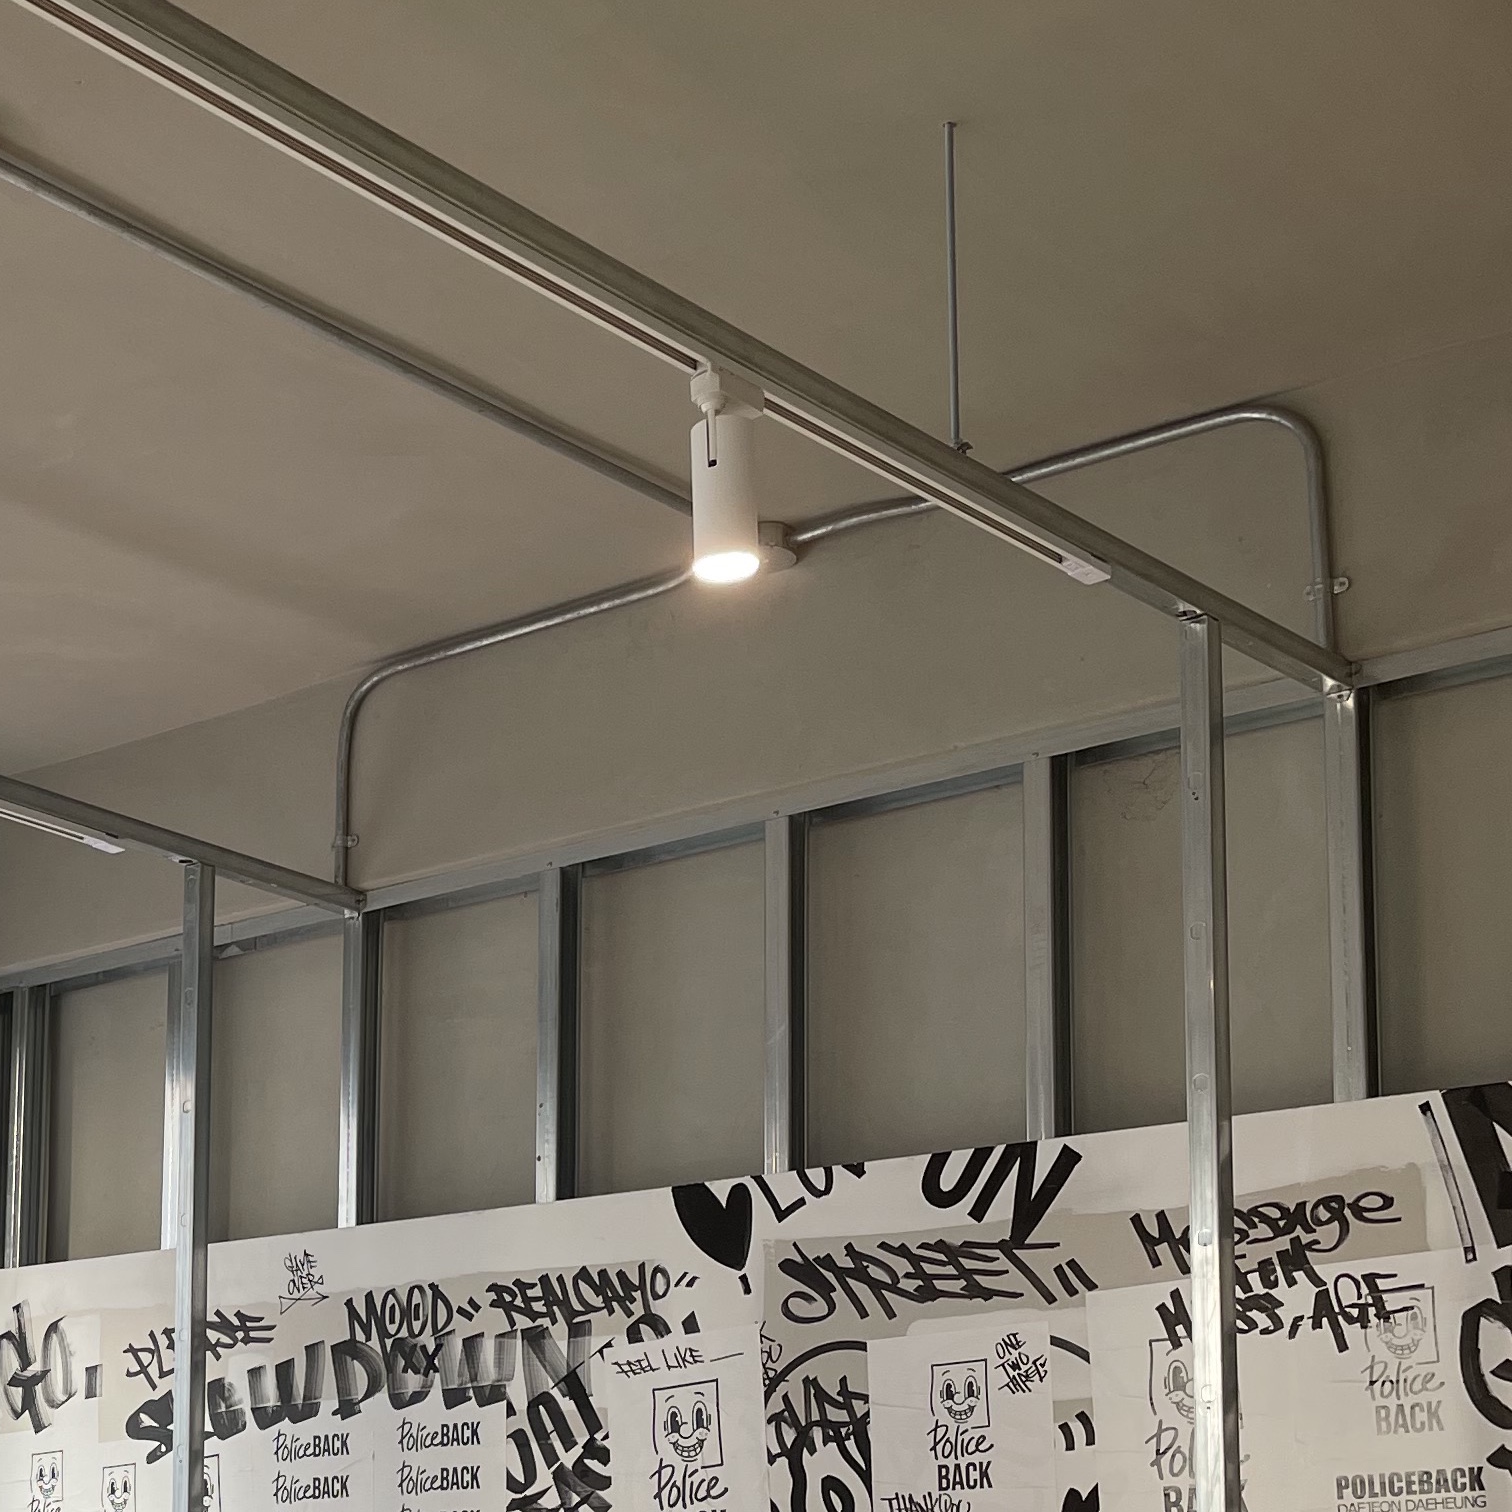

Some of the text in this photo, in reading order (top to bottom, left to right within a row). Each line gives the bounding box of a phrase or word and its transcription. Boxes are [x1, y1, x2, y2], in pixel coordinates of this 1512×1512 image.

[661, 1345, 705, 1371] LIKE
[995, 1332, 1026, 1360] ONE
[994, 1351, 1029, 1381] TWO
[1361, 1355, 1445, 1401] Police
[1375, 1400, 1445, 1436] BACK
[927, 1419, 994, 1460] Police
[649, 1458, 728, 1511] Police
[938, 1461, 993, 1491] BACK
[1336, 1467, 1486, 1500] POLICEBACK
[1405, 1495, 1487, 1512] DAEHEUNG
